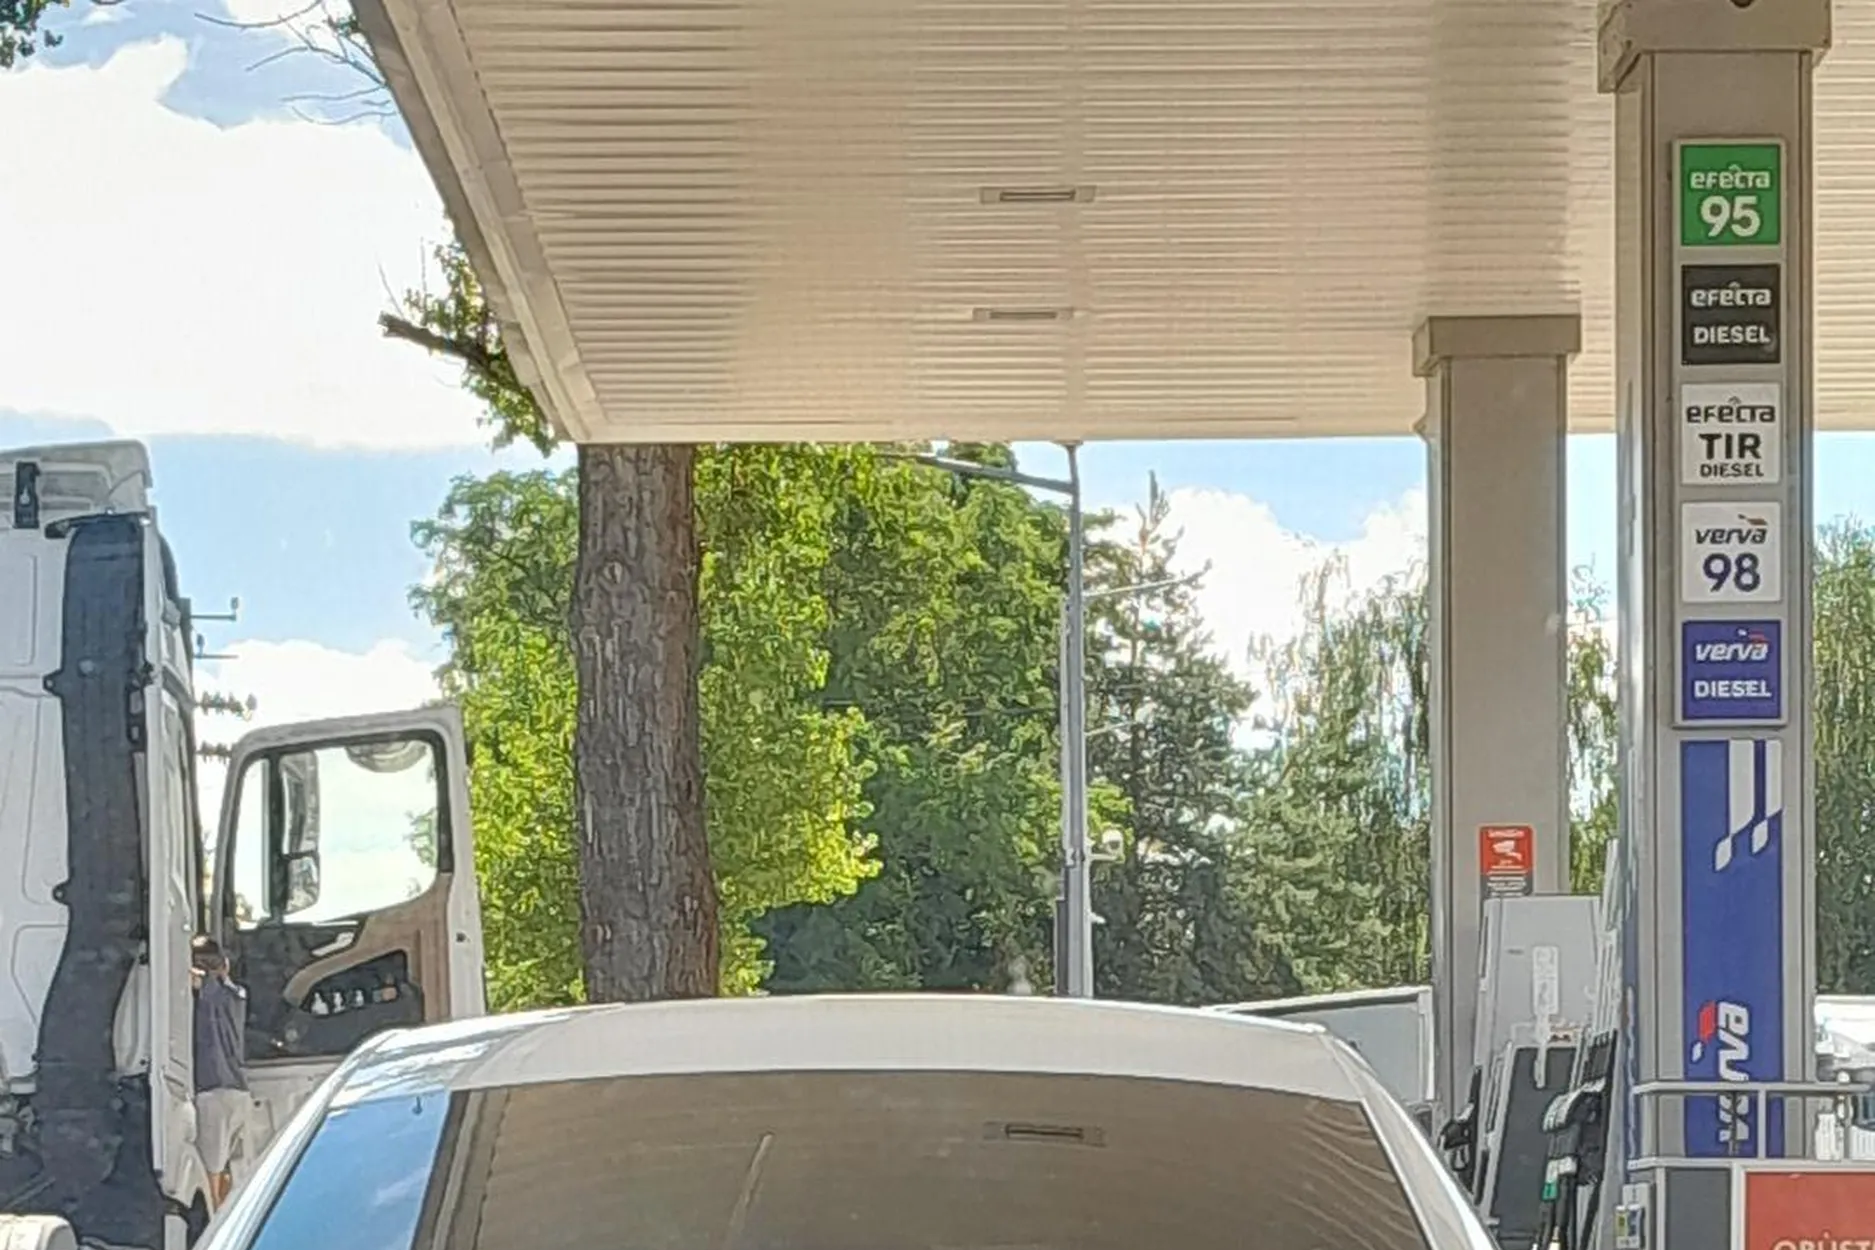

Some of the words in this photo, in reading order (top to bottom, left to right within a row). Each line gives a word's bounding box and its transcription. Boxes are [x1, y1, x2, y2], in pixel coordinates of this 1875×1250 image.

[1690, 166, 1771, 189] efecta
[1701, 195, 1760, 237] 95
[1690, 285, 1772, 307] efecta
[1693, 326, 1771, 344] DIESEL
[1686, 401, 1776, 424] efecta
[1698, 432, 1762, 460] TIR
[1699, 463, 1764, 478] DIESEL
[1695, 528, 1767, 545] verva
[1703, 553, 1760, 592] 98
[1695, 642, 1769, 662] verva
[1694, 679, 1771, 697] DIESEL
